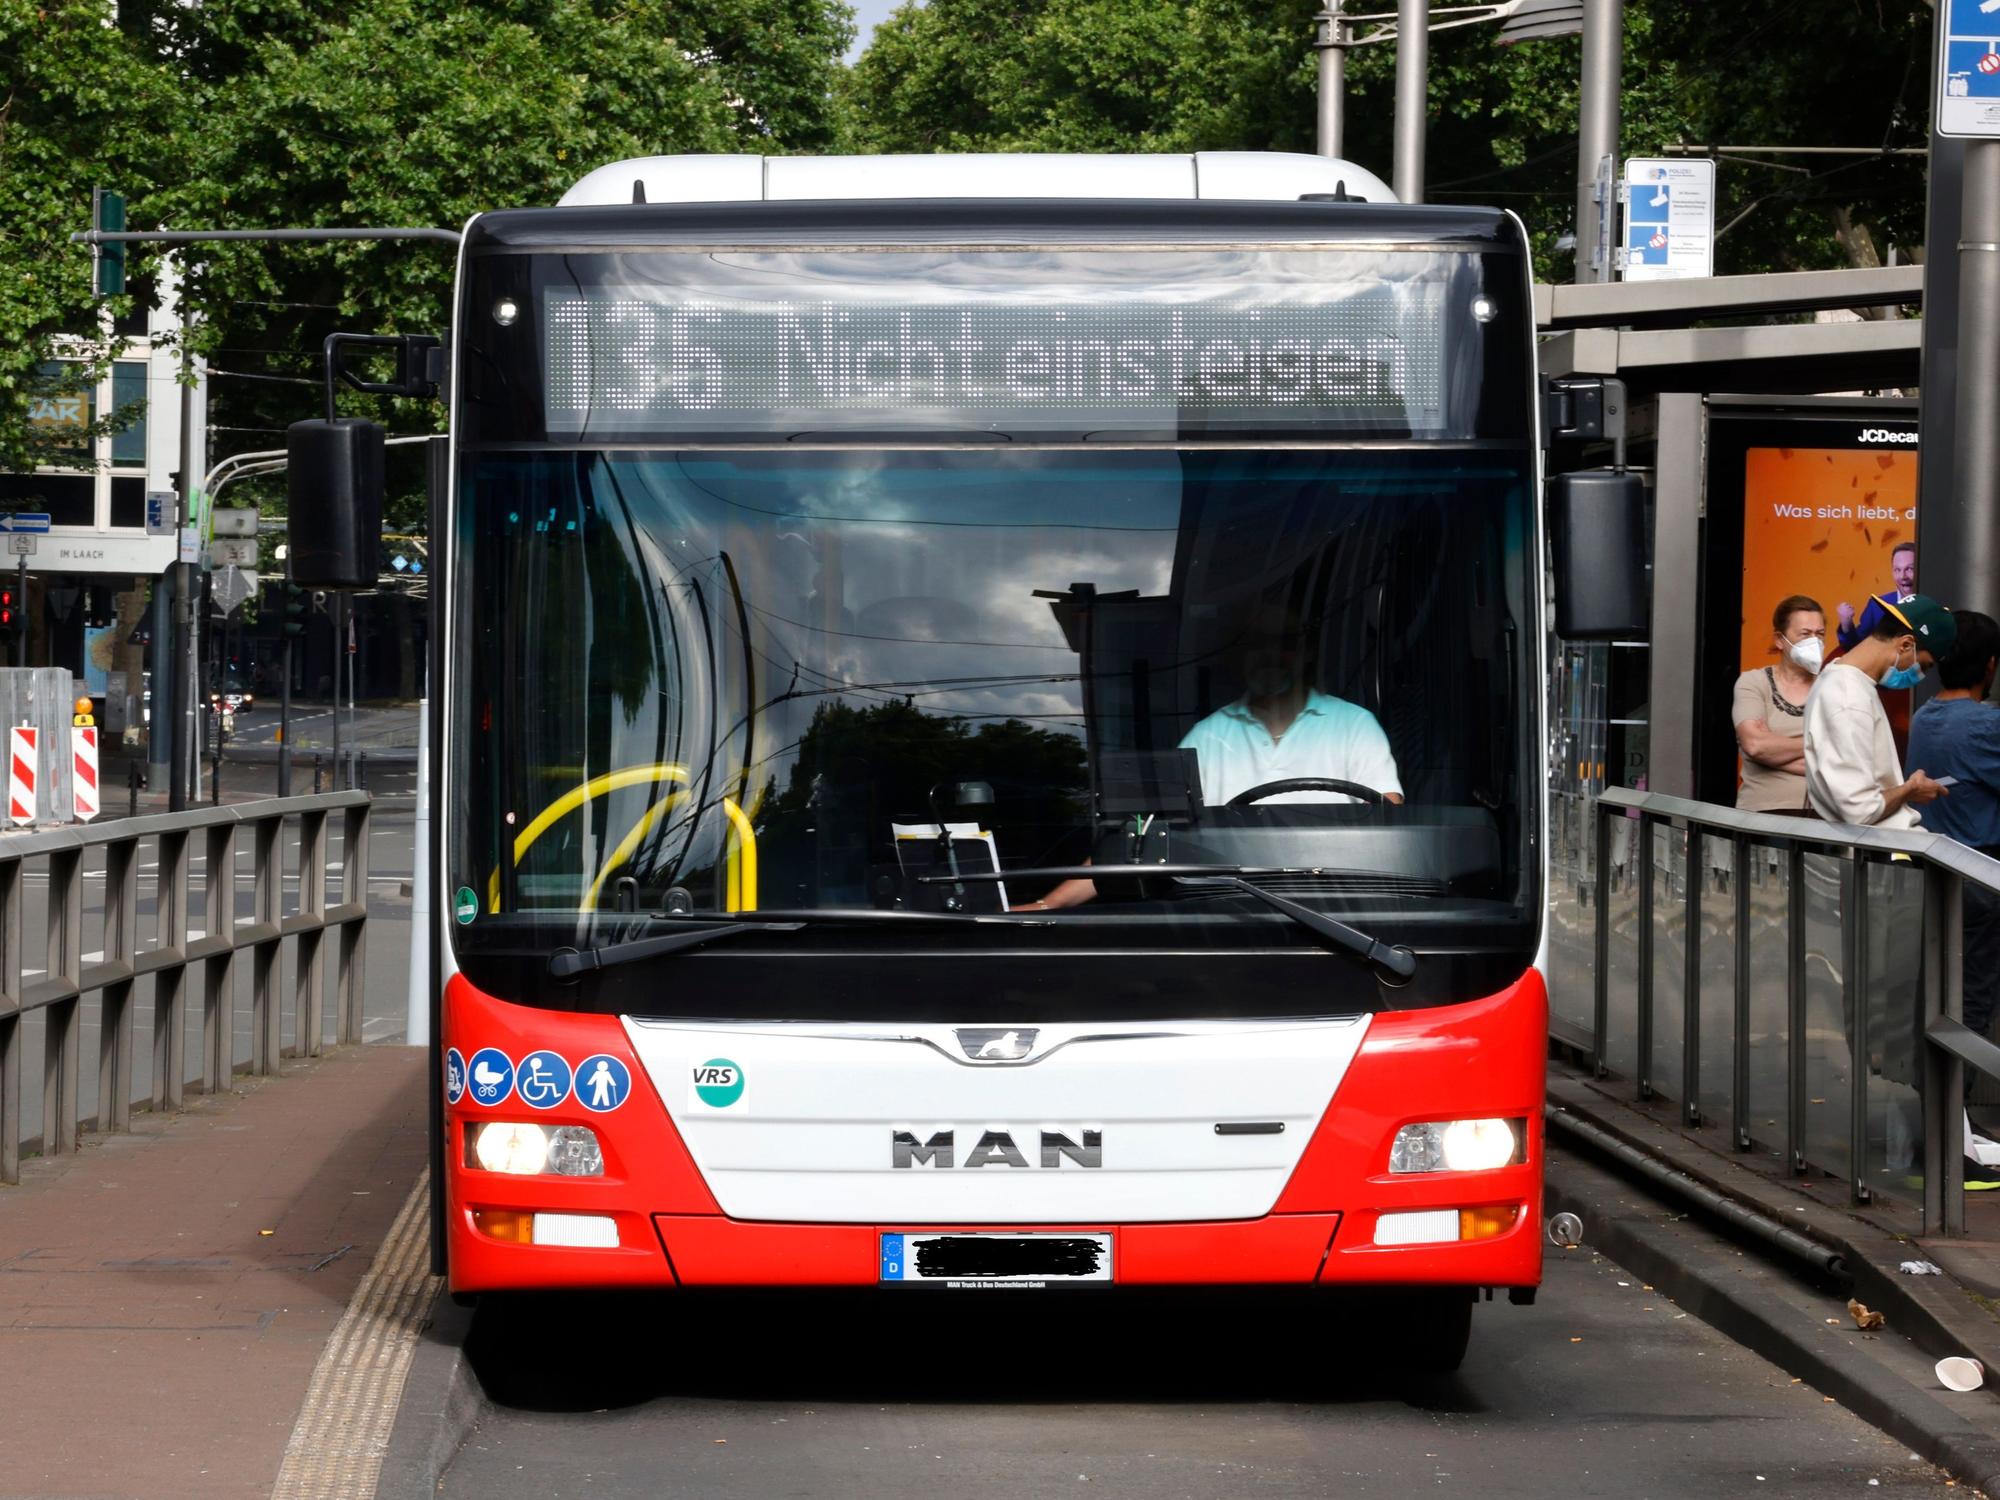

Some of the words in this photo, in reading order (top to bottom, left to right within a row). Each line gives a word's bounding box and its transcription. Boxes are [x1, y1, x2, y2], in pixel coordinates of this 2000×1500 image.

[555, 300, 722, 409] 136
[778, 300, 983, 397] Nicht
[1005, 310, 1405, 401] einsteigen
[1774, 503, 1812, 518] Was
[1817, 504, 1852, 519] sich
[1857, 505, 1900, 522] liebt,
[73, 550, 104, 559] LAACH
[693, 1068, 732, 1084] VRS
[892, 1129, 1102, 1168] MAN
[889, 1263, 898, 1273] D
